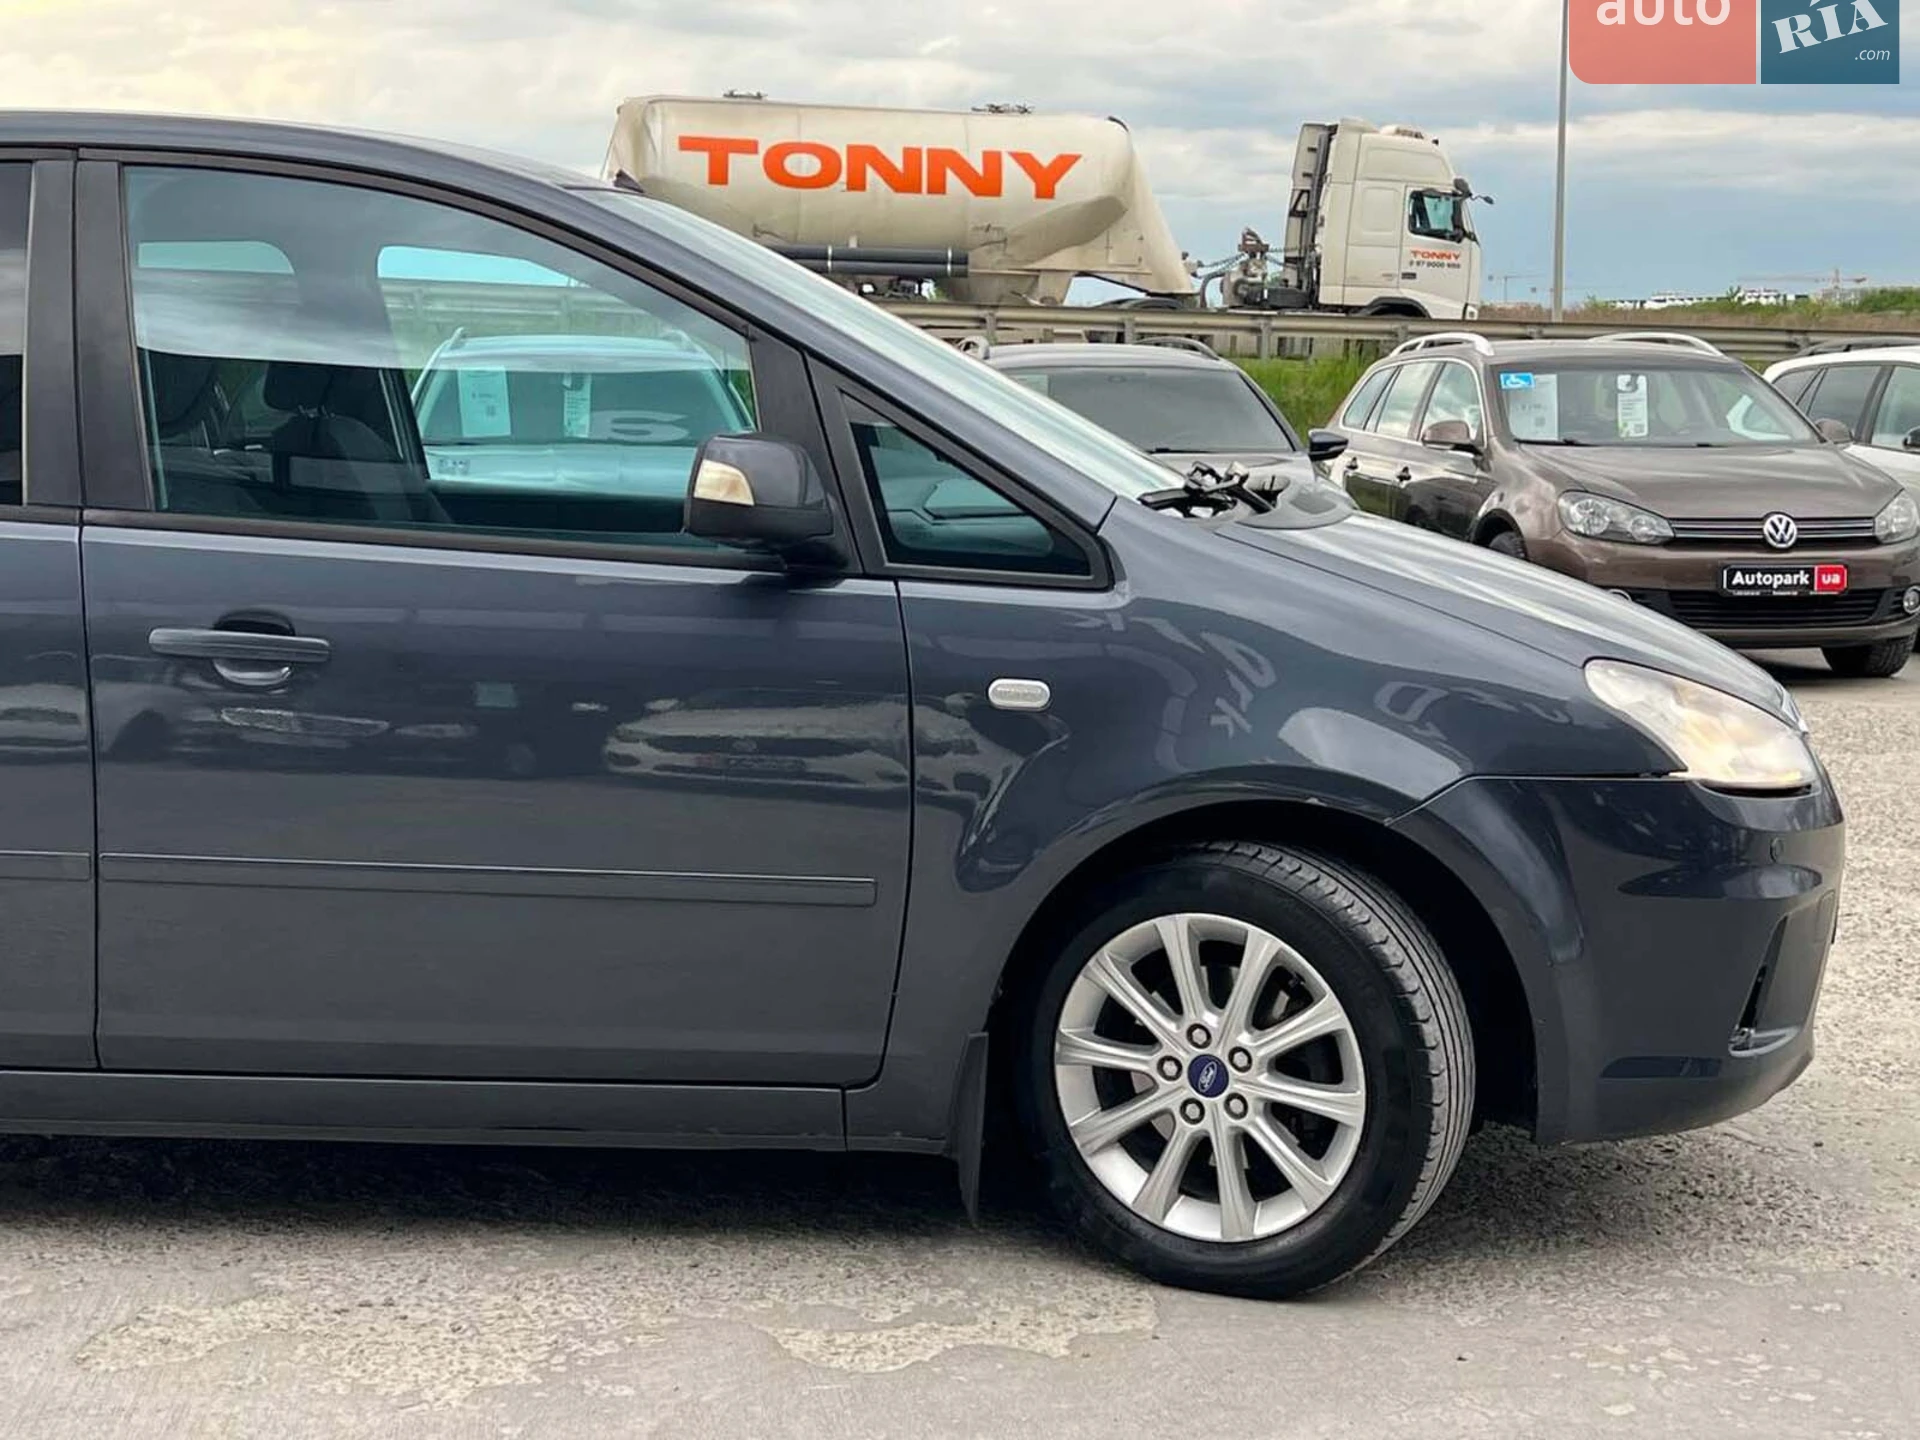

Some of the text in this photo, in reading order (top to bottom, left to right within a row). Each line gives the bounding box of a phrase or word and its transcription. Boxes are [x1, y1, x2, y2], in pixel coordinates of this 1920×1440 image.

[678, 135, 1083, 200] TONNY
[1410, 250, 1461, 261] TONNY
[1731, 570, 1841, 589] Autopark ua
